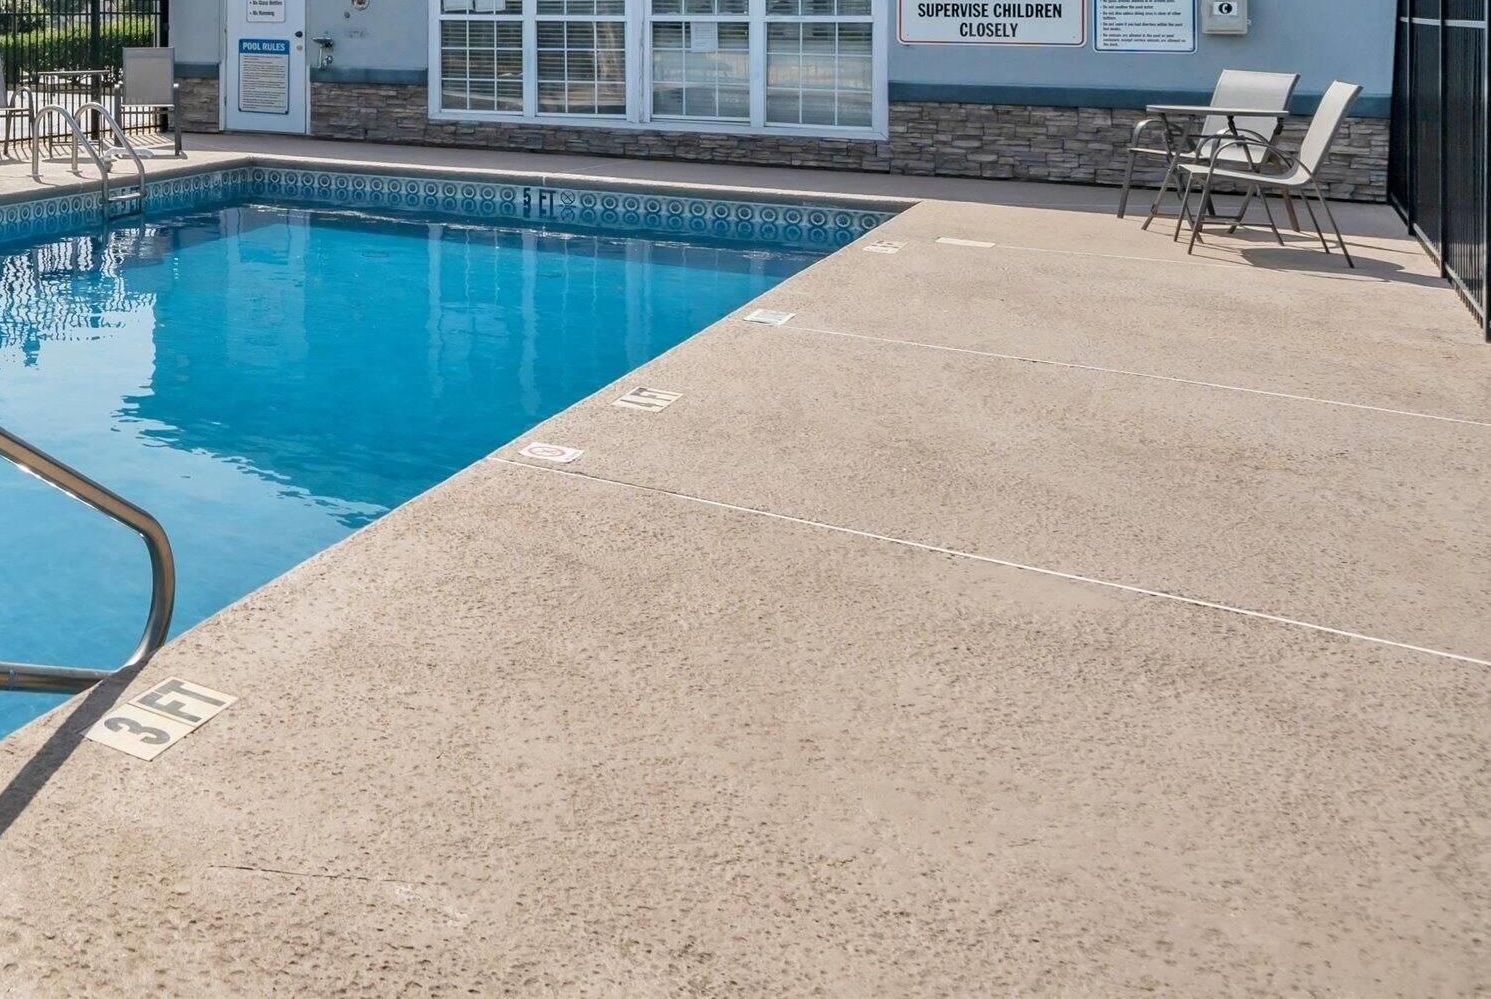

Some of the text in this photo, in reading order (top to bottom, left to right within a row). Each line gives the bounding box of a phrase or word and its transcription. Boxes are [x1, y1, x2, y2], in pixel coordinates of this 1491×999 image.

[918, 3, 1062, 18] SUPERVISE CHILDREN
[959, 23, 1018, 38] CLOSELY
[243, 42, 286, 51] POOL RULES
[523, 187, 557, 206] 5 FT
[629, 387, 679, 402] FT
[103, 679, 227, 745] 3 FT
